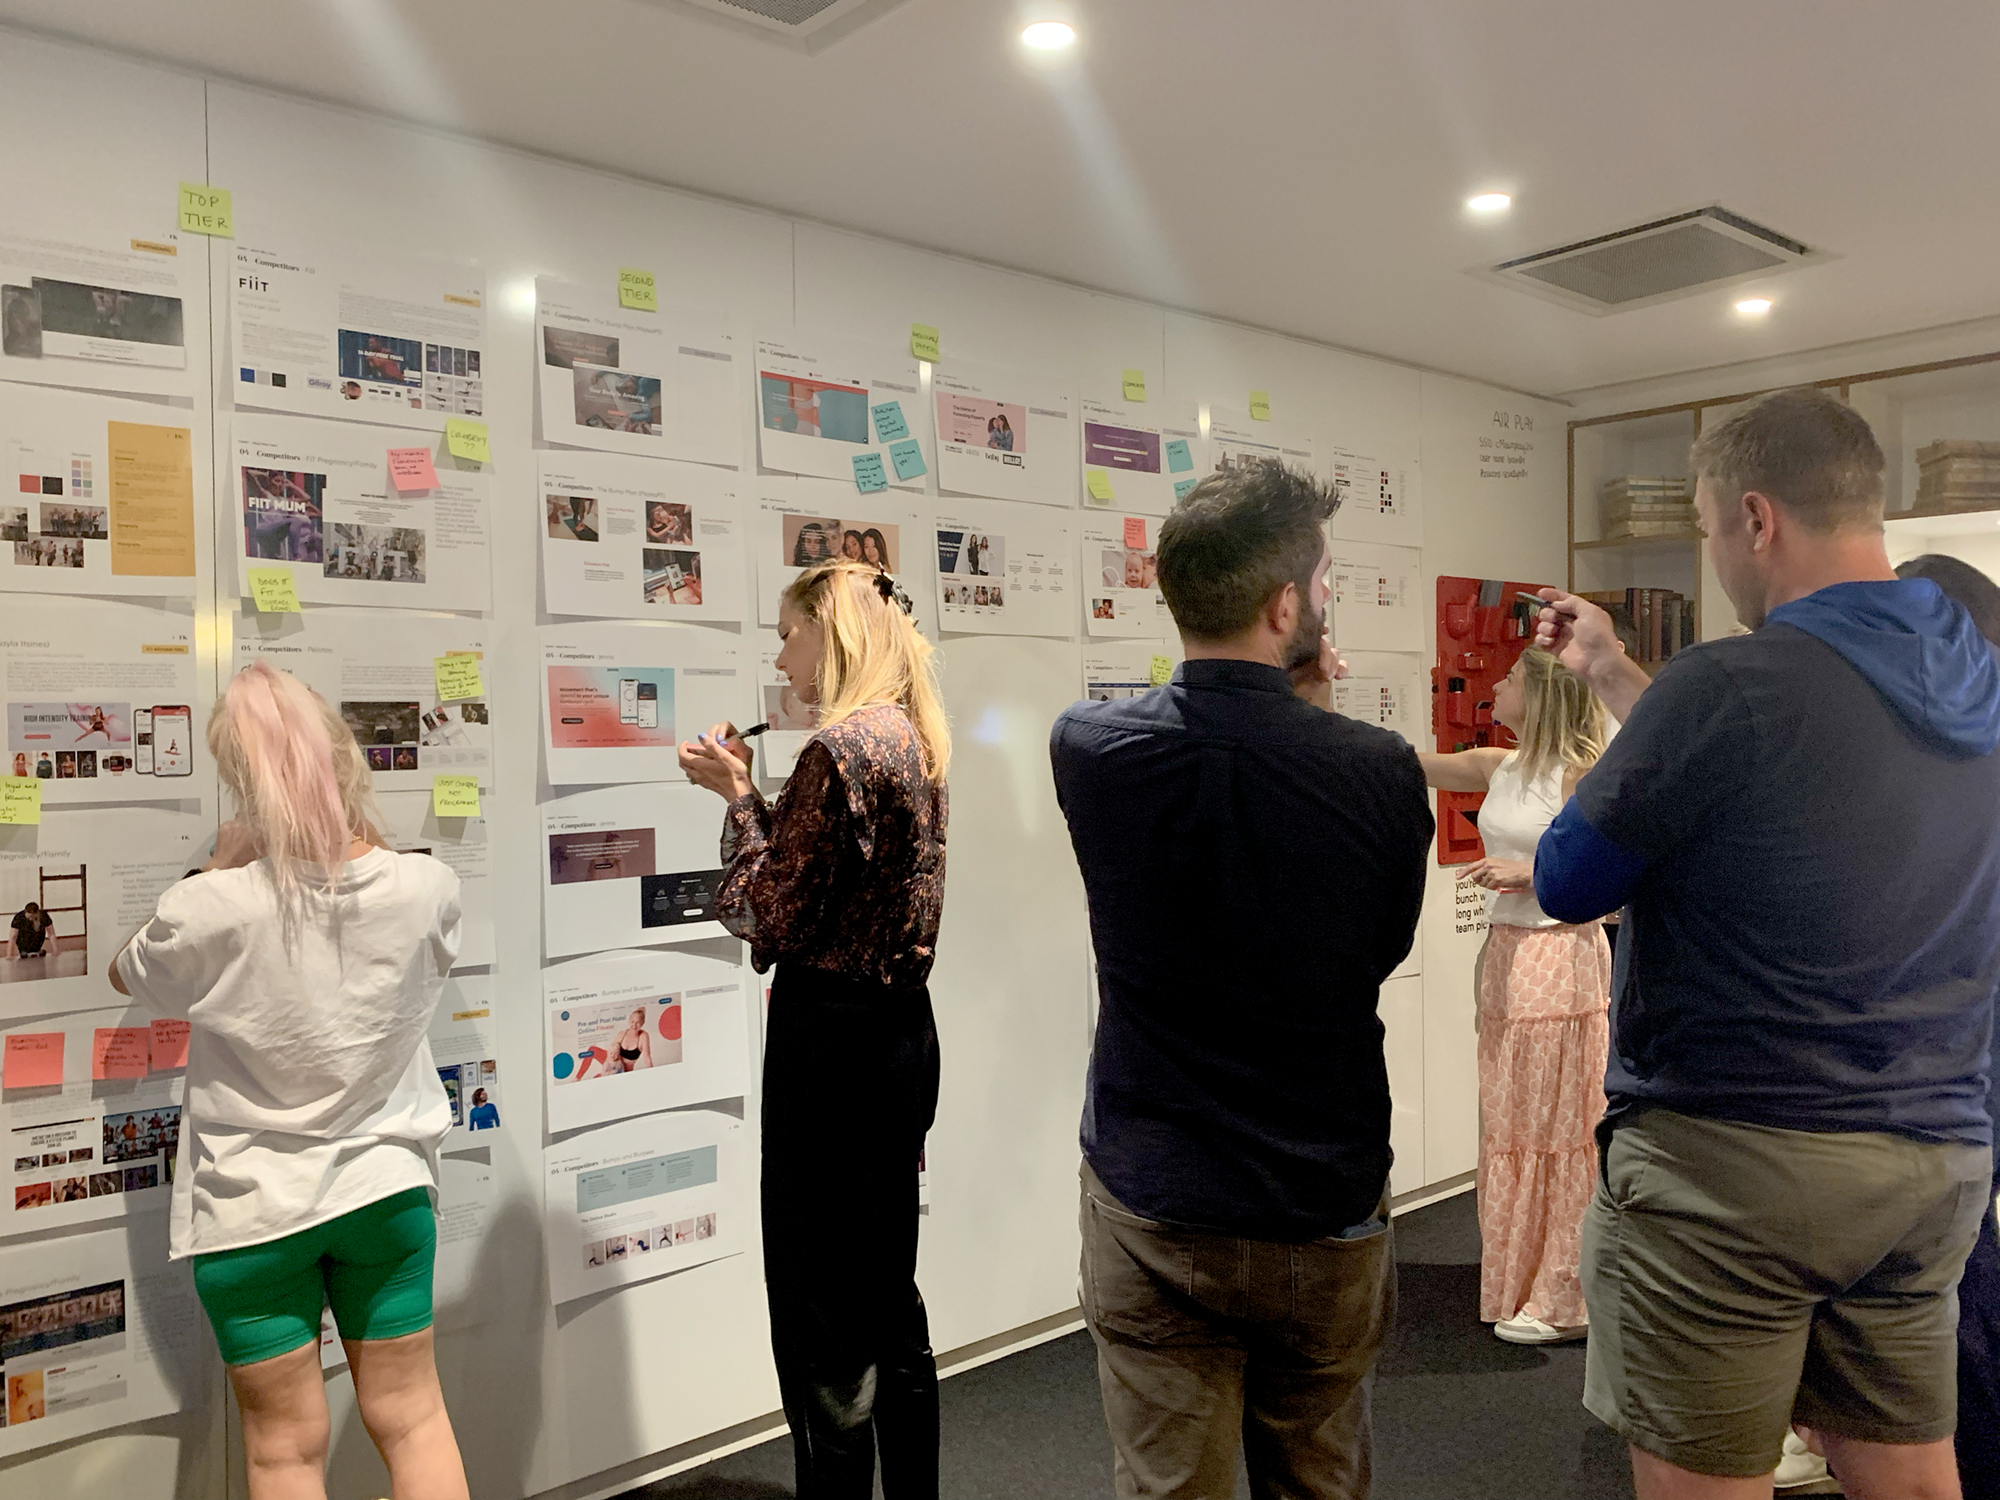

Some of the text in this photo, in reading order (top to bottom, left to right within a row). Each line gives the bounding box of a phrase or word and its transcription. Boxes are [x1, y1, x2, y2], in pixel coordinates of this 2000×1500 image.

[183, 190, 220, 208] TOP
[184, 212, 228, 229] TIER
[255, 258, 300, 272] Competitors
[620, 273, 655, 287] SECOND
[623, 287, 653, 302] TIER
[555, 312, 590, 322] Competitors
[770, 350, 799, 360] Competitors
[308, 379, 331, 390] Gilroy
[1493, 411, 1533, 431] AIR PLAY
[256, 450, 301, 462] Competitors
[558, 482, 593, 491] Competitors
[274, 499, 306, 513] MUM
[772, 505, 801, 513] Competitors
[257, 577, 279, 586] DOES
[20, 640, 50, 648] Itsines)
[258, 645, 302, 653] Competitors
[308, 646, 333, 654] Peloton
[38, 714, 68, 723] INTENSITY
[561, 821, 596, 829] Competitors
[1455, 879, 1476, 893] you're
[1456, 892, 1478, 905] bunch
[1456, 908, 1471, 920] long
[1456, 924, 1474, 934] team
[563, 993, 597, 1002] Competitors
[612, 1015, 626, 1023] Natal
[564, 1161, 599, 1172] Competitors
